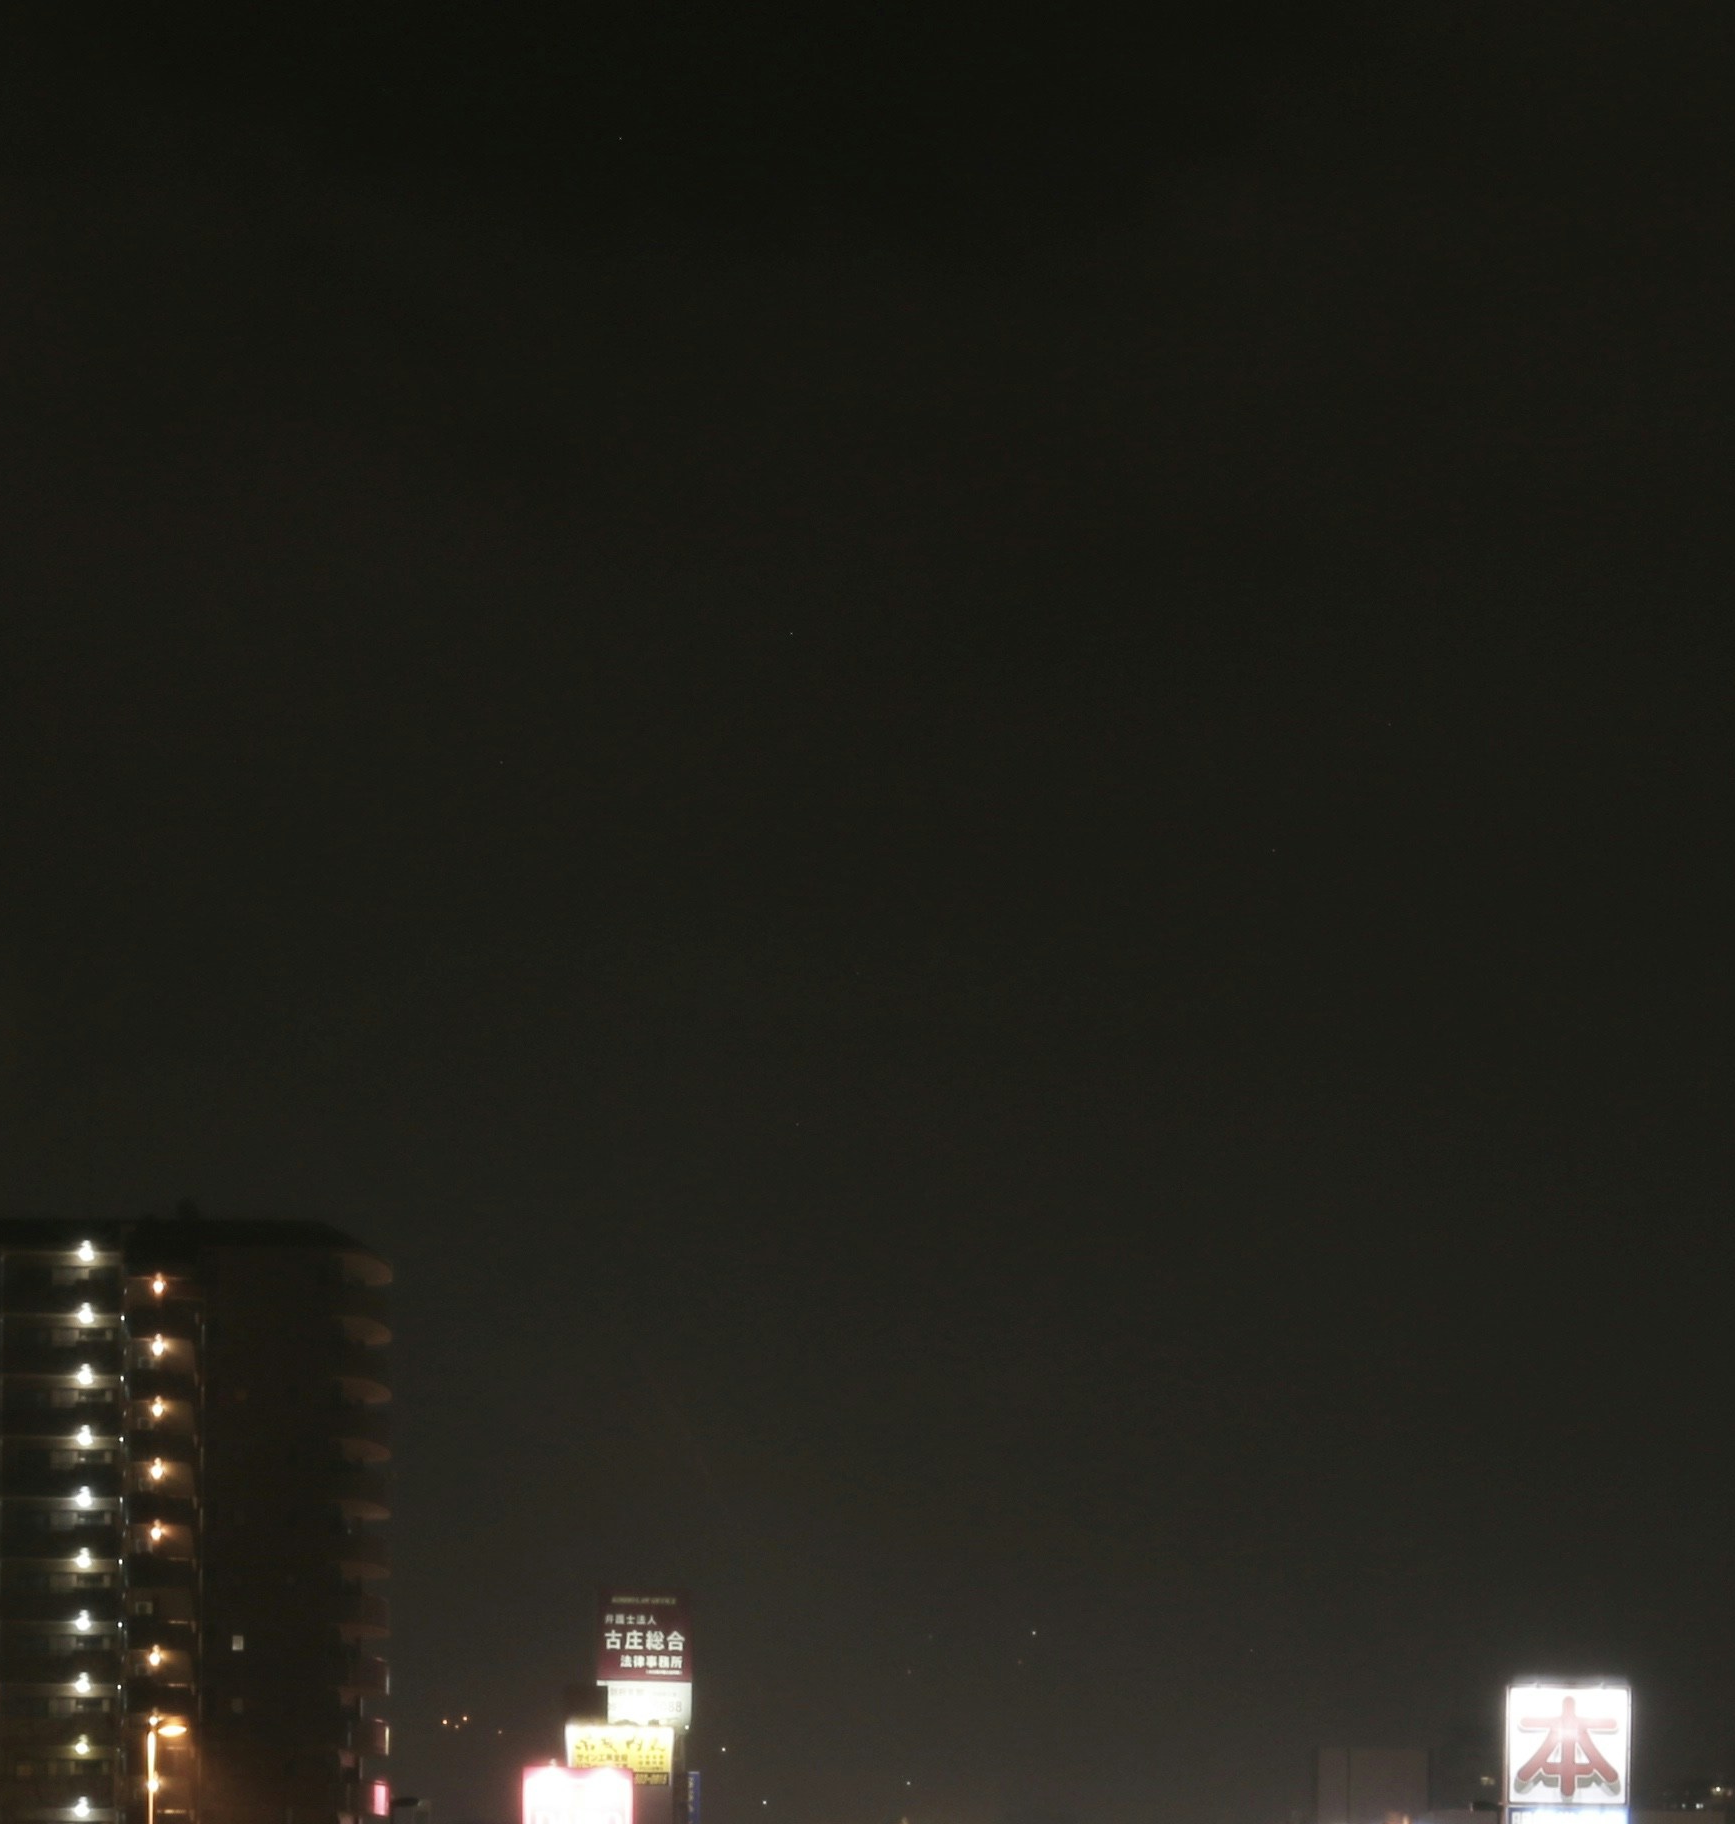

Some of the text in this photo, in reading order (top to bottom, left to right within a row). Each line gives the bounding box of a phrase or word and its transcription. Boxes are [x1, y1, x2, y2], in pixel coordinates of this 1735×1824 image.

[604, 1629, 686, 1651] 古庄総合
[620, 1655, 683, 1668] 法律事務所
[1517, 1695, 1619, 1800] 本
